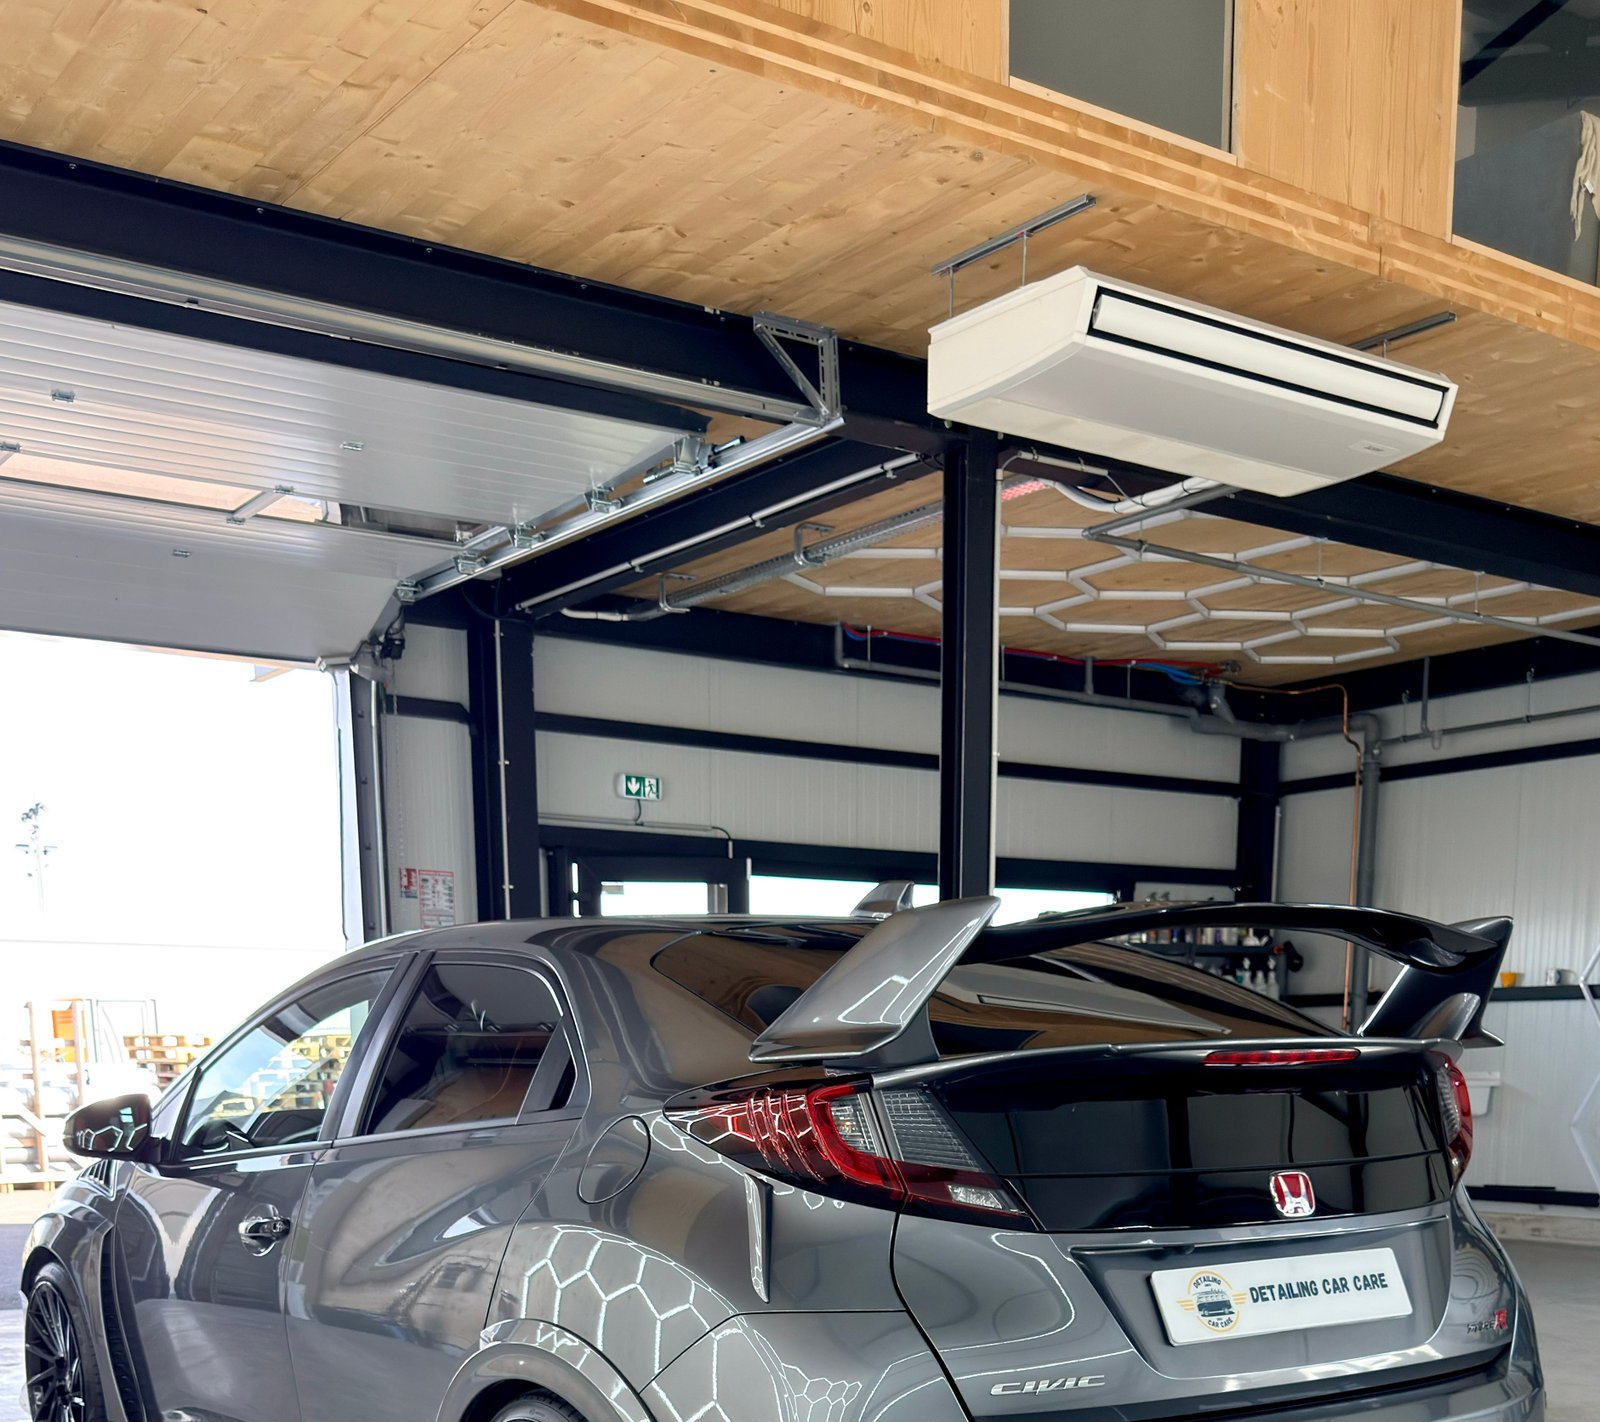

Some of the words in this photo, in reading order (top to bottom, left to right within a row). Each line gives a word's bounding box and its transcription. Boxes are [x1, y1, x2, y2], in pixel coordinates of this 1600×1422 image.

[1193, 1275, 1222, 1289] DETAILING
[1249, 1280, 1319, 1304] DETAILING
[1322, 1276, 1350, 1295] CAR
[1353, 1272, 1389, 1291] CARE
[1207, 1319, 1220, 1328] CAR
[1220, 1316, 1234, 1328] CARE
[990, 1374, 1106, 1396] CIVIC
